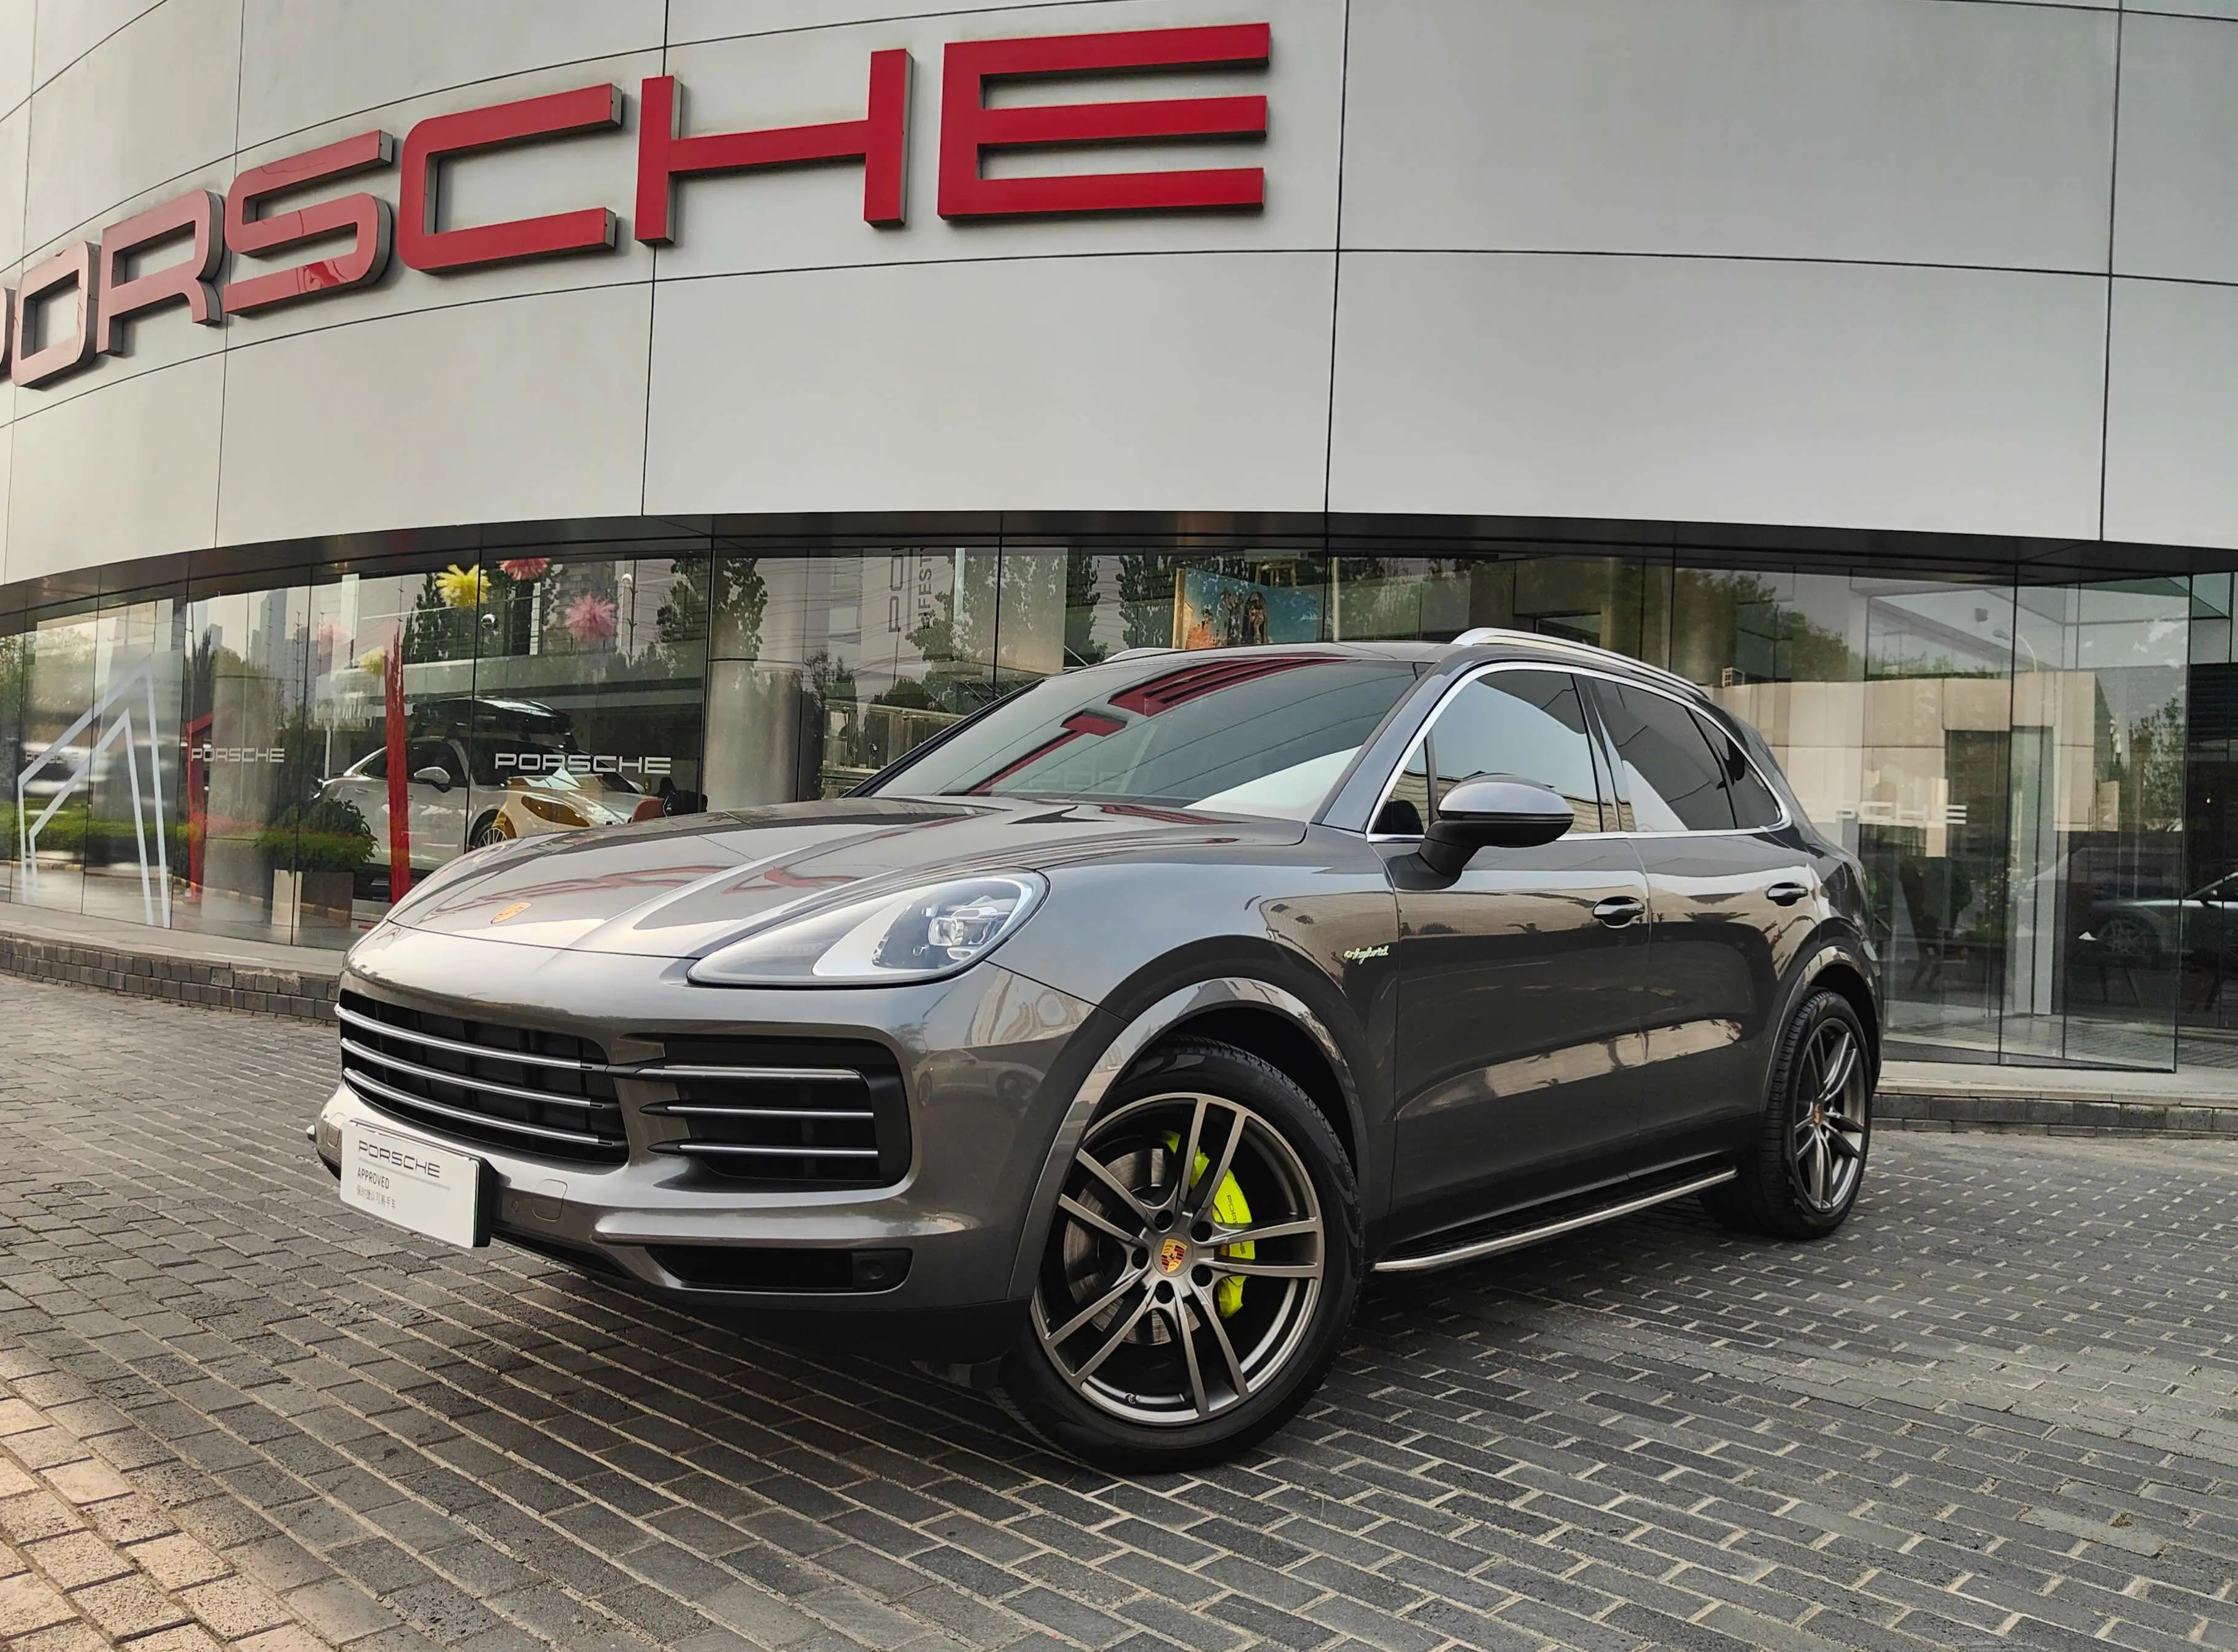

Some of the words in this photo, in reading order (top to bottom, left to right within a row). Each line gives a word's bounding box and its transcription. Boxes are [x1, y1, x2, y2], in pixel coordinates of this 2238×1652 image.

[0, 22, 1271, 389] ORSCHE
[191, 747, 285, 763] PORSCHE
[495, 753, 672, 774] PORSCHE
[358, 1140, 441, 1178] PORSCHE
[357, 1167, 390, 1189] APPROVED
